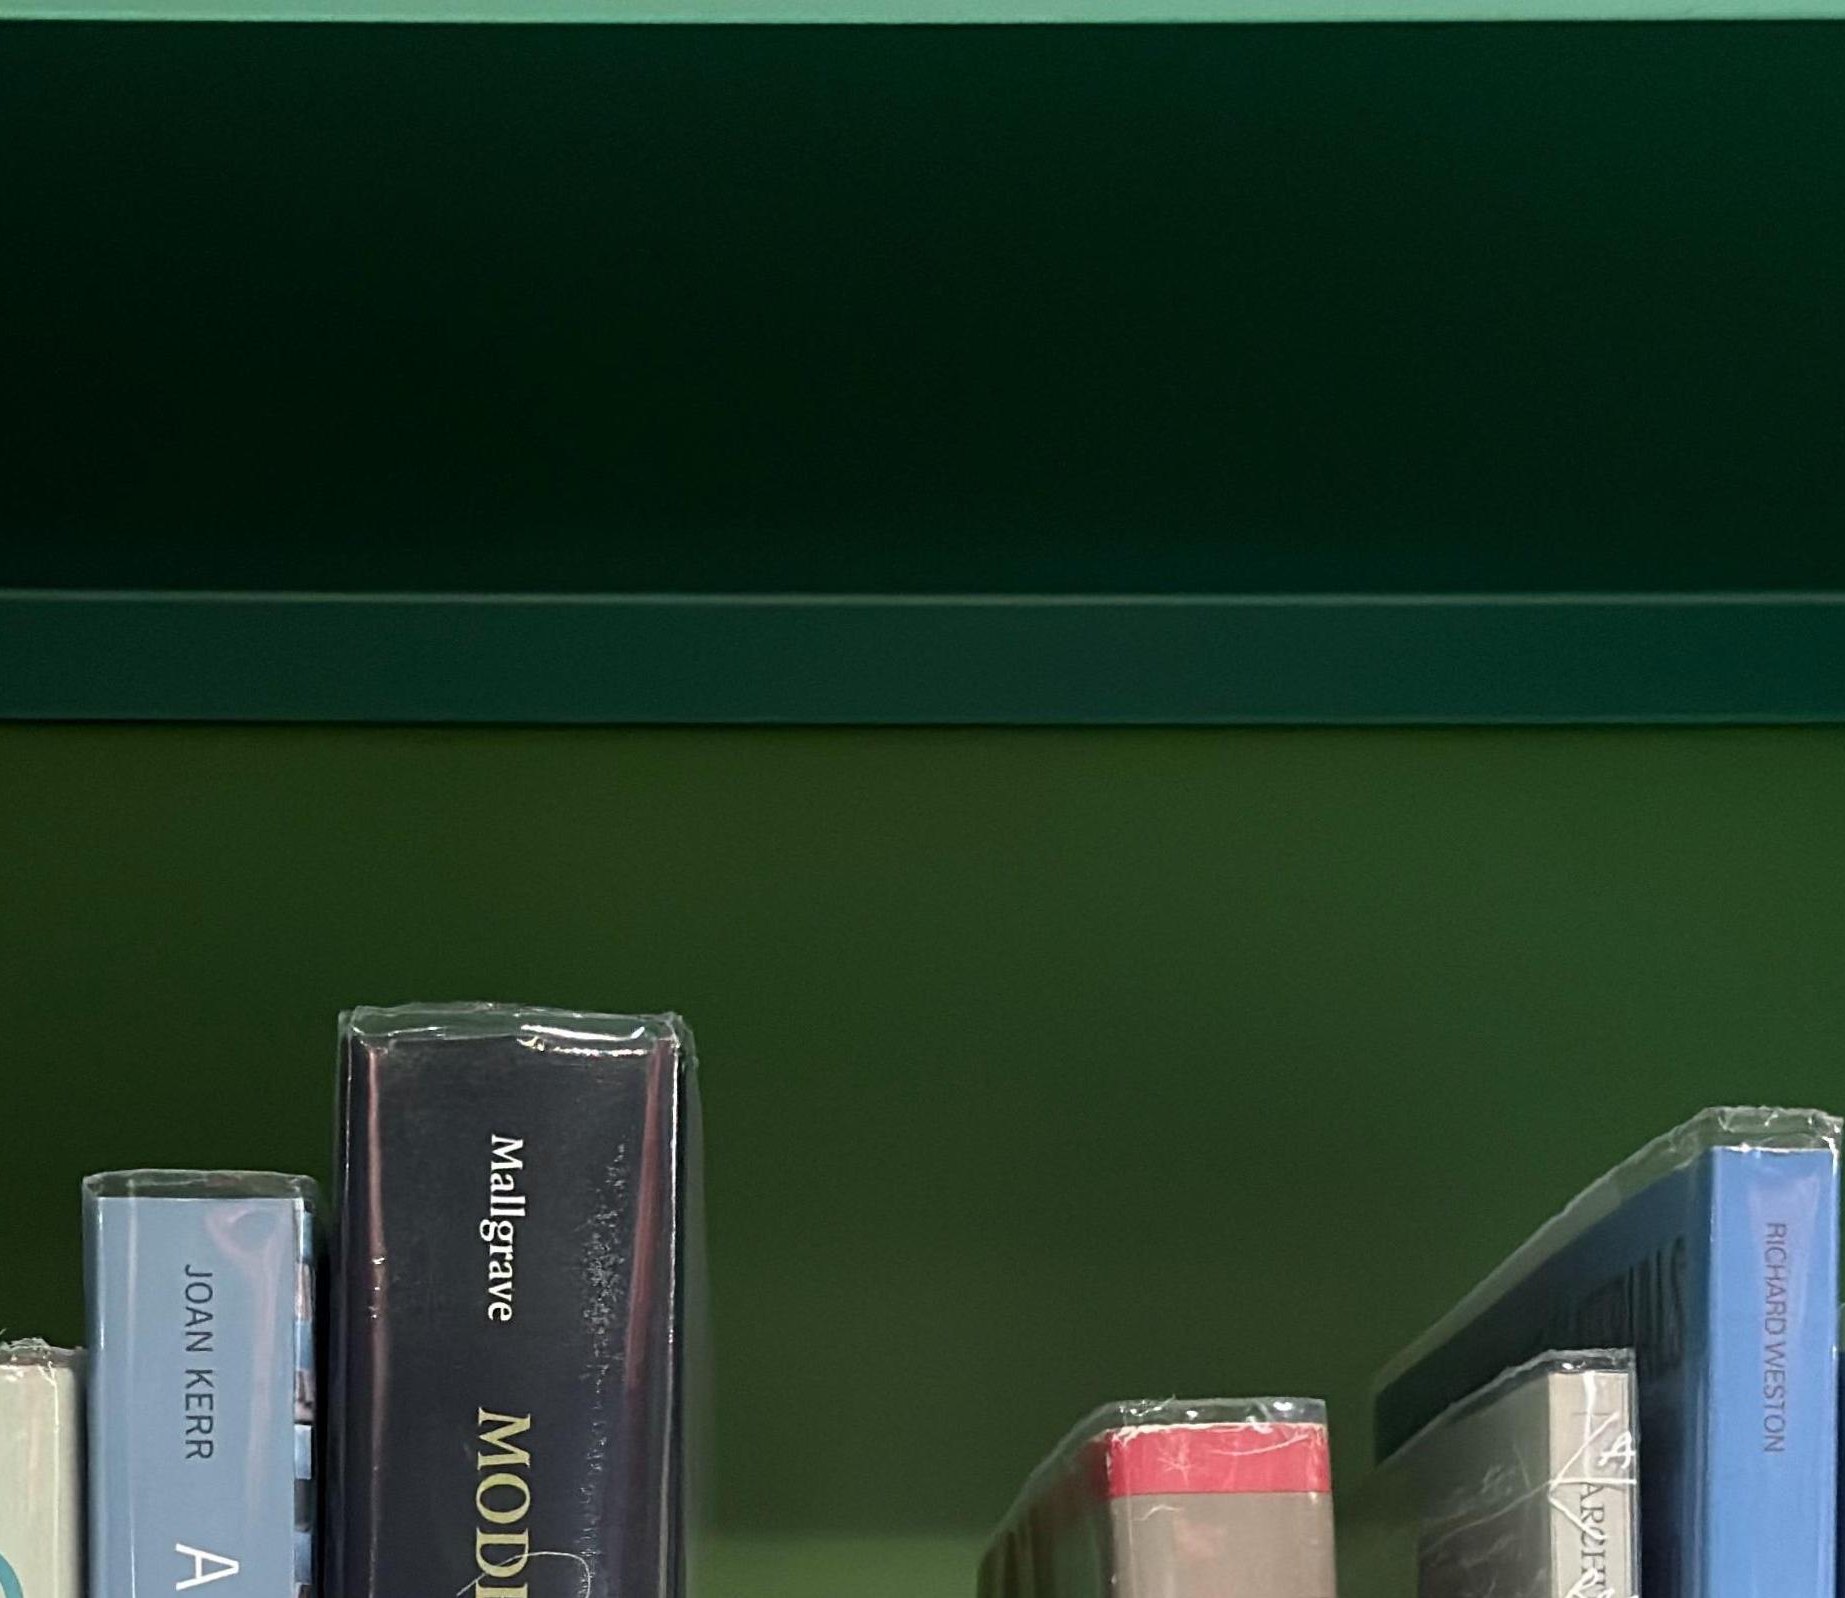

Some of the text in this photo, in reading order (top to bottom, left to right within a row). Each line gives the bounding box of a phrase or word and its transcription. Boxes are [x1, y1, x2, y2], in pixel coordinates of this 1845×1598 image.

[480, 1134, 526, 1321] Mallgrave
[183, 1263, 214, 1462] JOAN KERR
[1762, 1221, 1788, 1453] RICHARD WESTON
[175, 1543, 241, 1592] A
